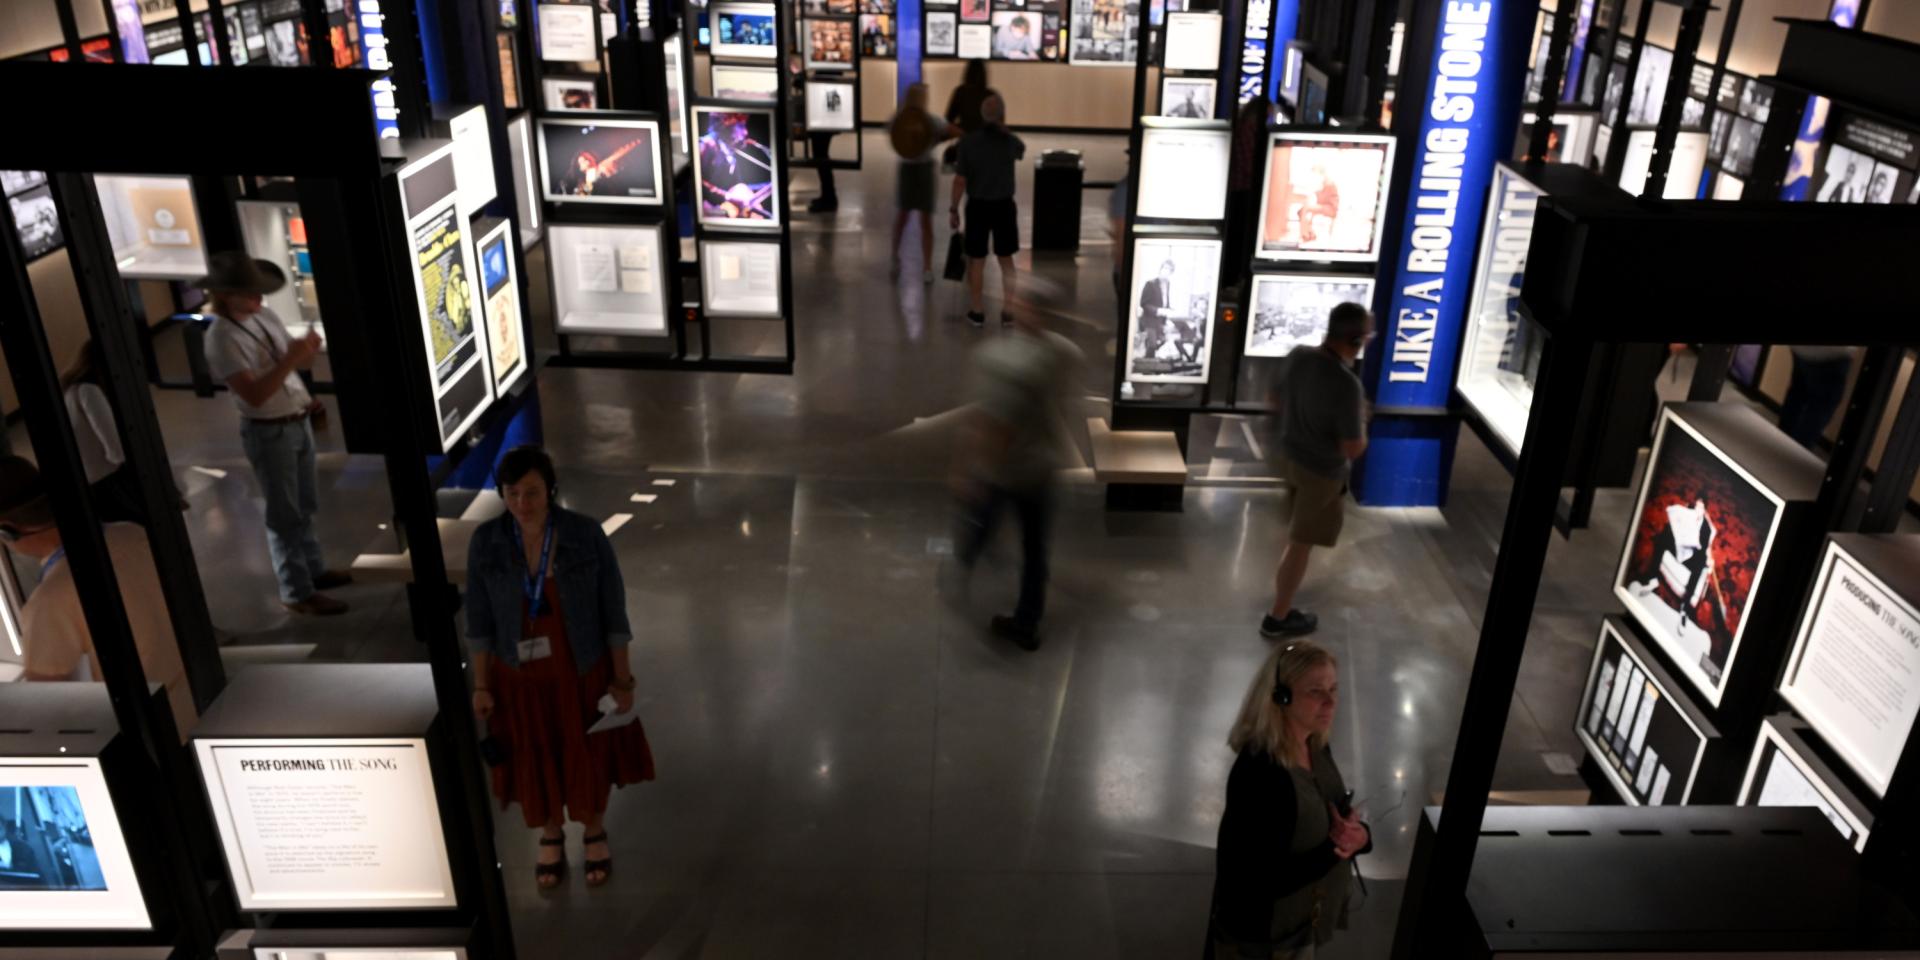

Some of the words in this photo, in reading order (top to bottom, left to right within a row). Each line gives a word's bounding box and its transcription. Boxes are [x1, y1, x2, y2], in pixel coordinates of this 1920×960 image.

[1430, 1, 1493, 122] STONE
[1406, 127, 1470, 272] ROLLING
[1403, 277, 1445, 303] A
[1389, 308, 1440, 383] LIKE
[1840, 575, 1882, 616] PRODUCING
[1880, 607, 1899, 630] THE
[240, 759, 325, 772] PERFORMING
[328, 758, 356, 771] THE
[359, 757, 398, 771] SONG
